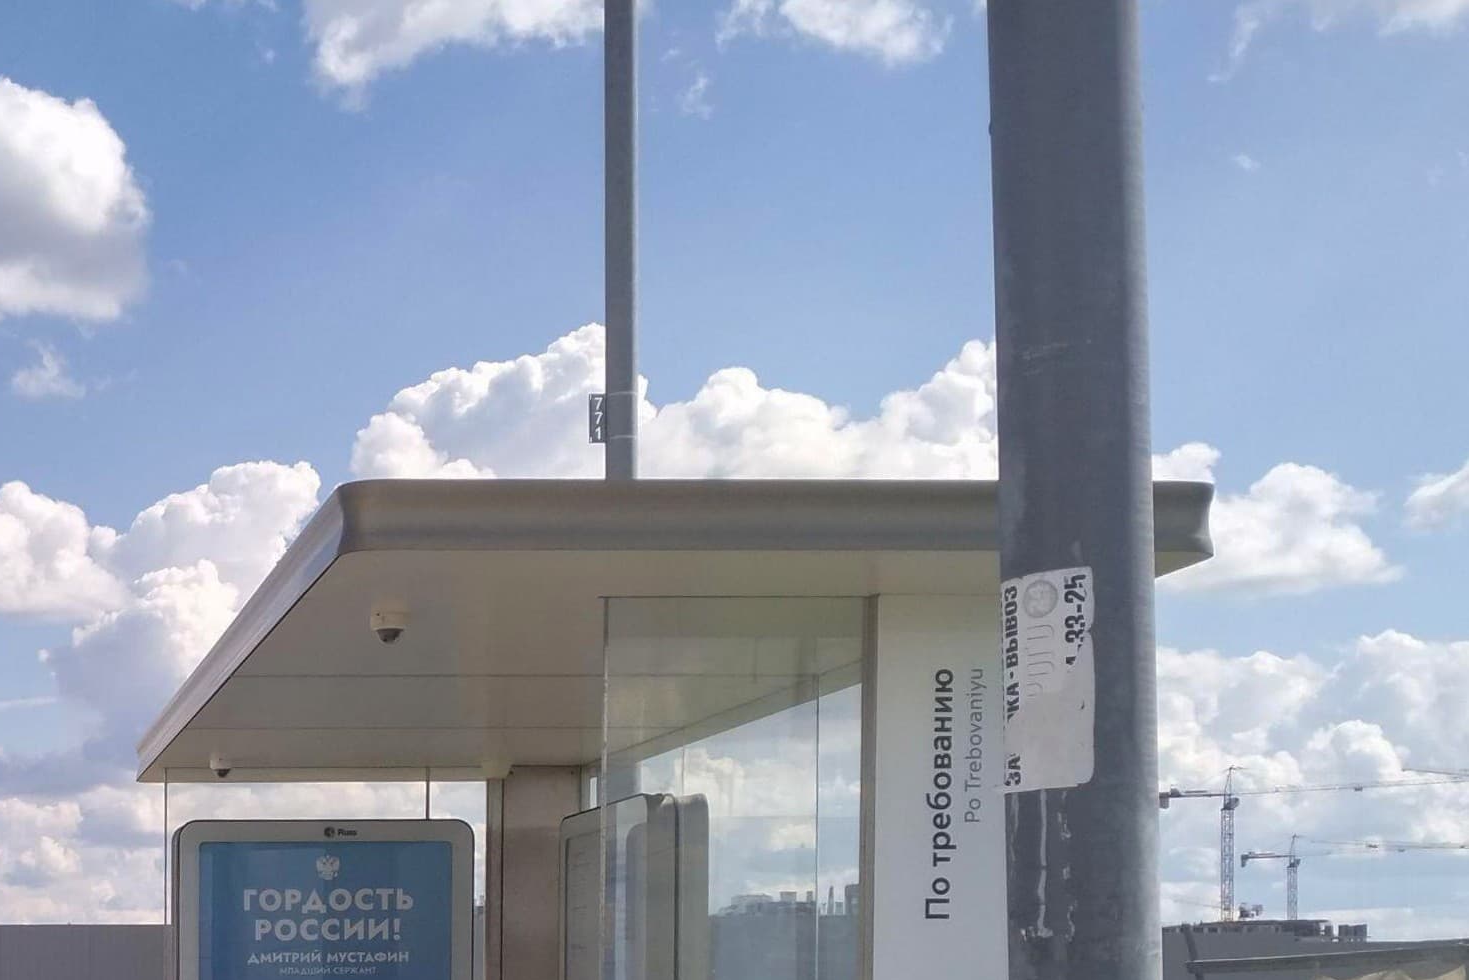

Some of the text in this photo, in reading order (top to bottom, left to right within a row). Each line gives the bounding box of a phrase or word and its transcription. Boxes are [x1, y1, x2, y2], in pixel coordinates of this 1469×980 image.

[594, 397, 604, 441] 771
[964, 667, 988, 823] Po Trebovaniyu
[924, 668, 957, 920] По требованию
[242, 887, 415, 914] ГОРДОСТЬ
[254, 918, 402, 942] РОССИИ!
[246, 949, 411, 966] ДМИТРИЙ МУСТАФИН
